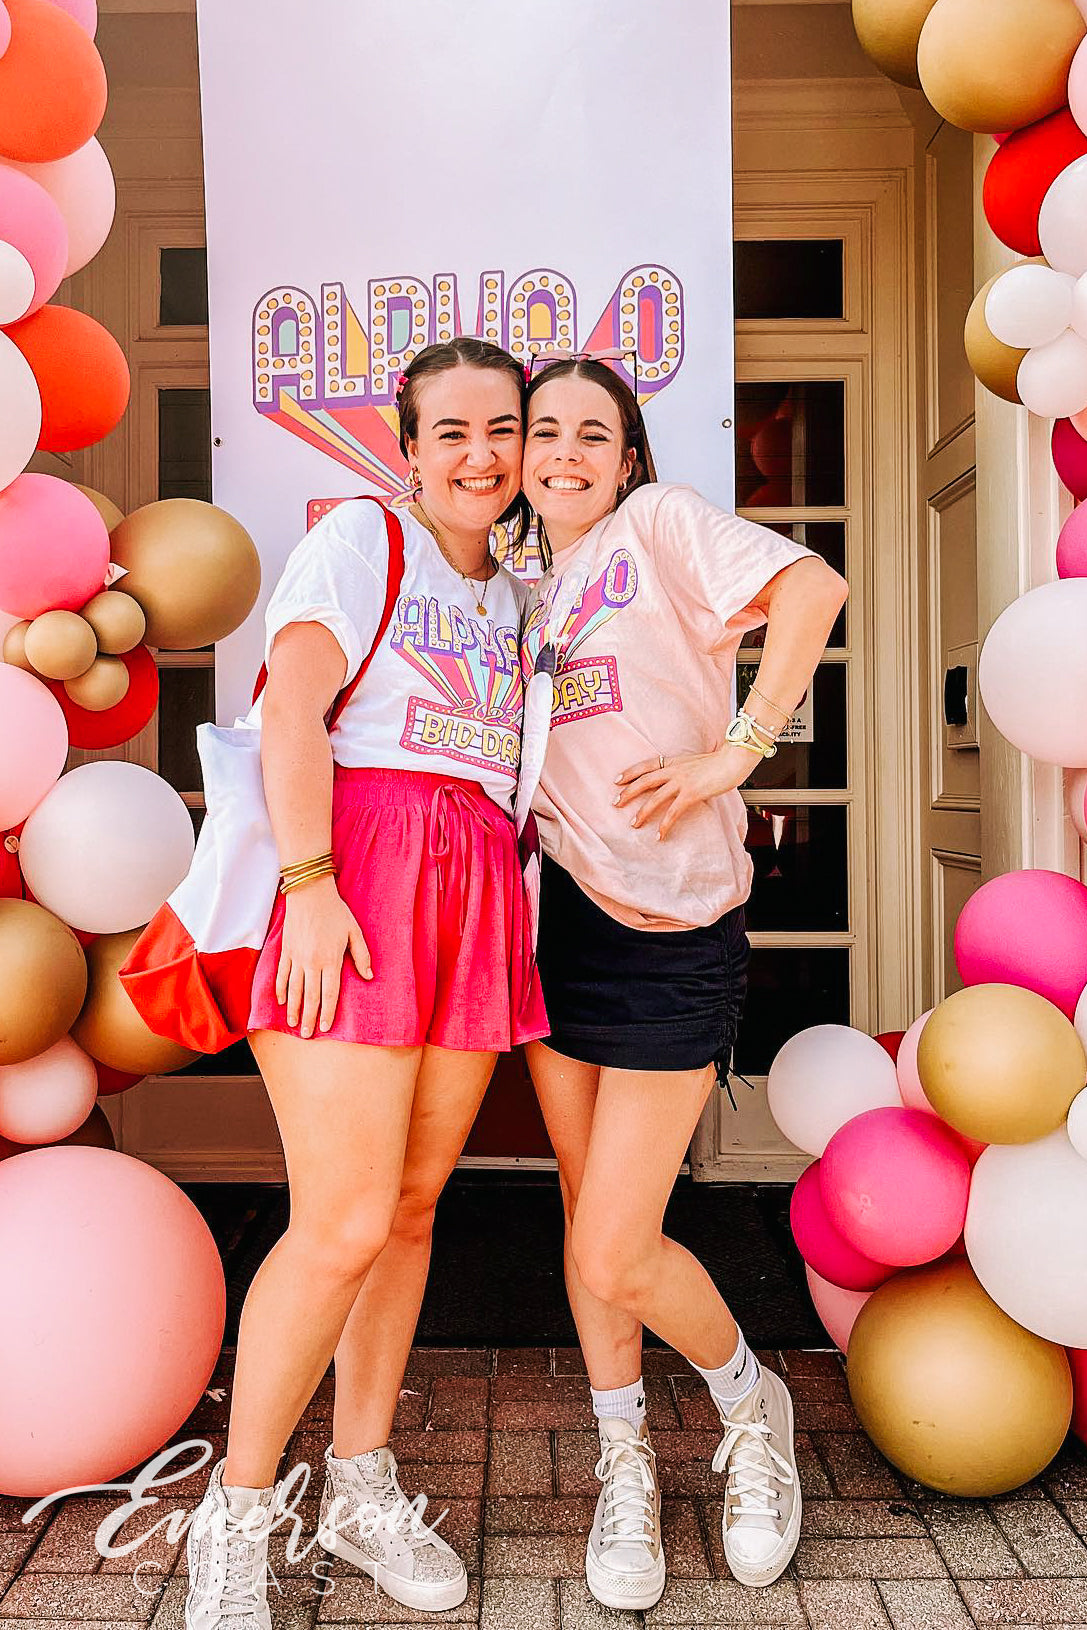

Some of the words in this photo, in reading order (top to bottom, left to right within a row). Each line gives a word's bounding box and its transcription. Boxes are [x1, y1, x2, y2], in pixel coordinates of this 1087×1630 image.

[613, 263, 685, 392] O
[391, 594, 519, 676] ALPHA
[421, 713, 477, 750] BID
[451, 697, 516, 727] 2023
